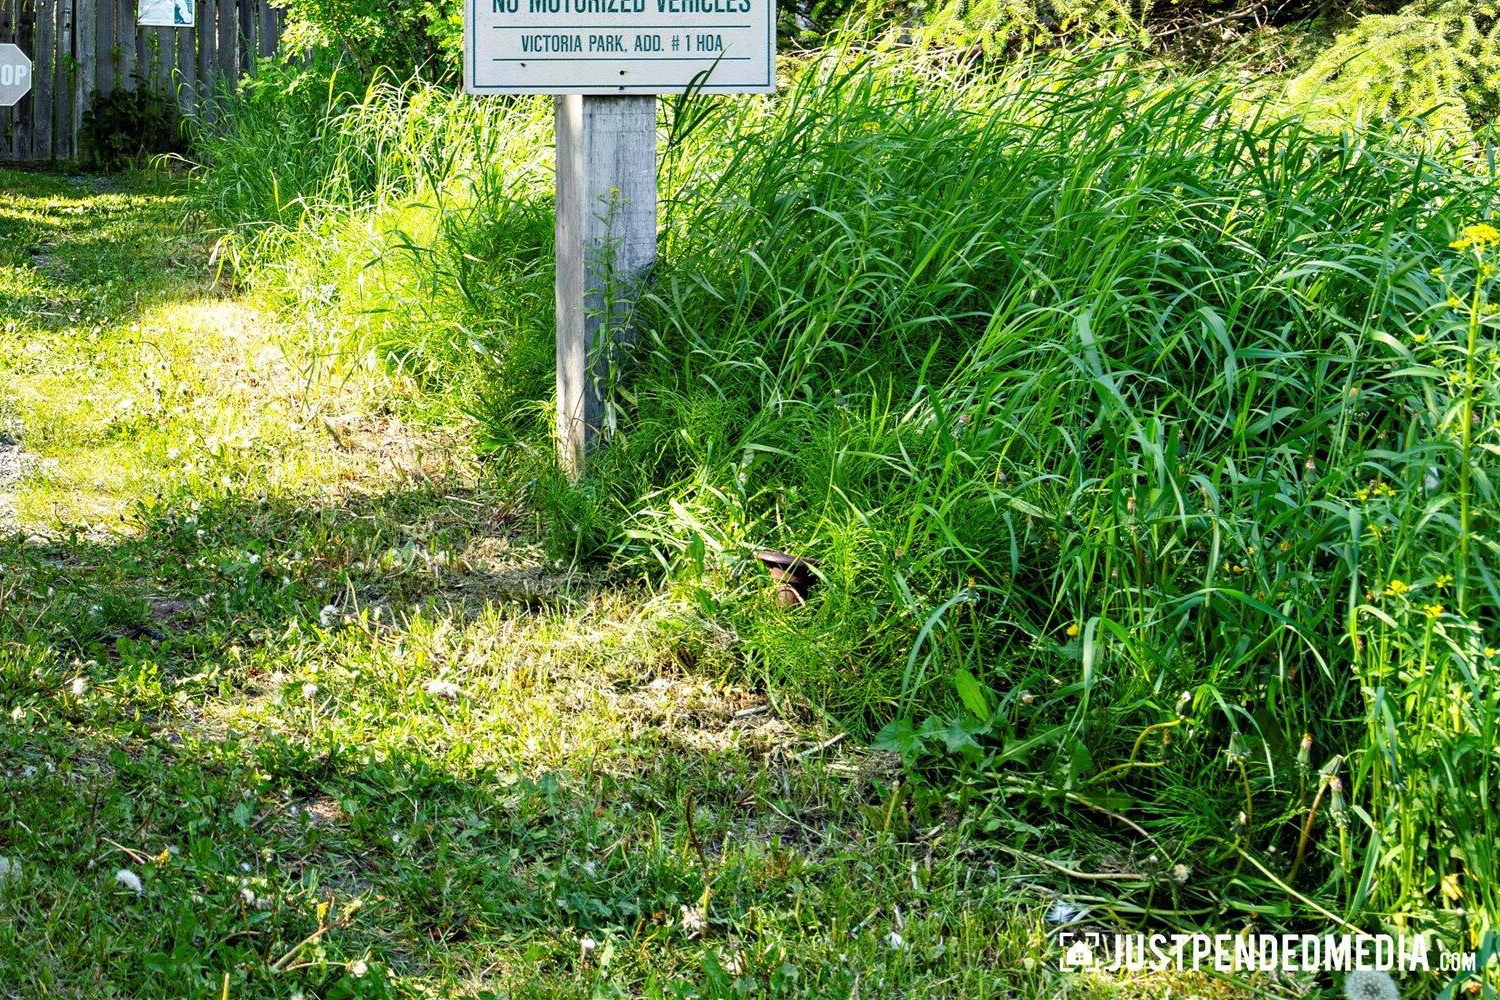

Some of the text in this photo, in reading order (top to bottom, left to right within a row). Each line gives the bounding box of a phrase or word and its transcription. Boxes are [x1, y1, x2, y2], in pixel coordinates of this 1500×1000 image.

[521, 34, 724, 54] VICTORIA PARK, ADD. # 1 HOA
